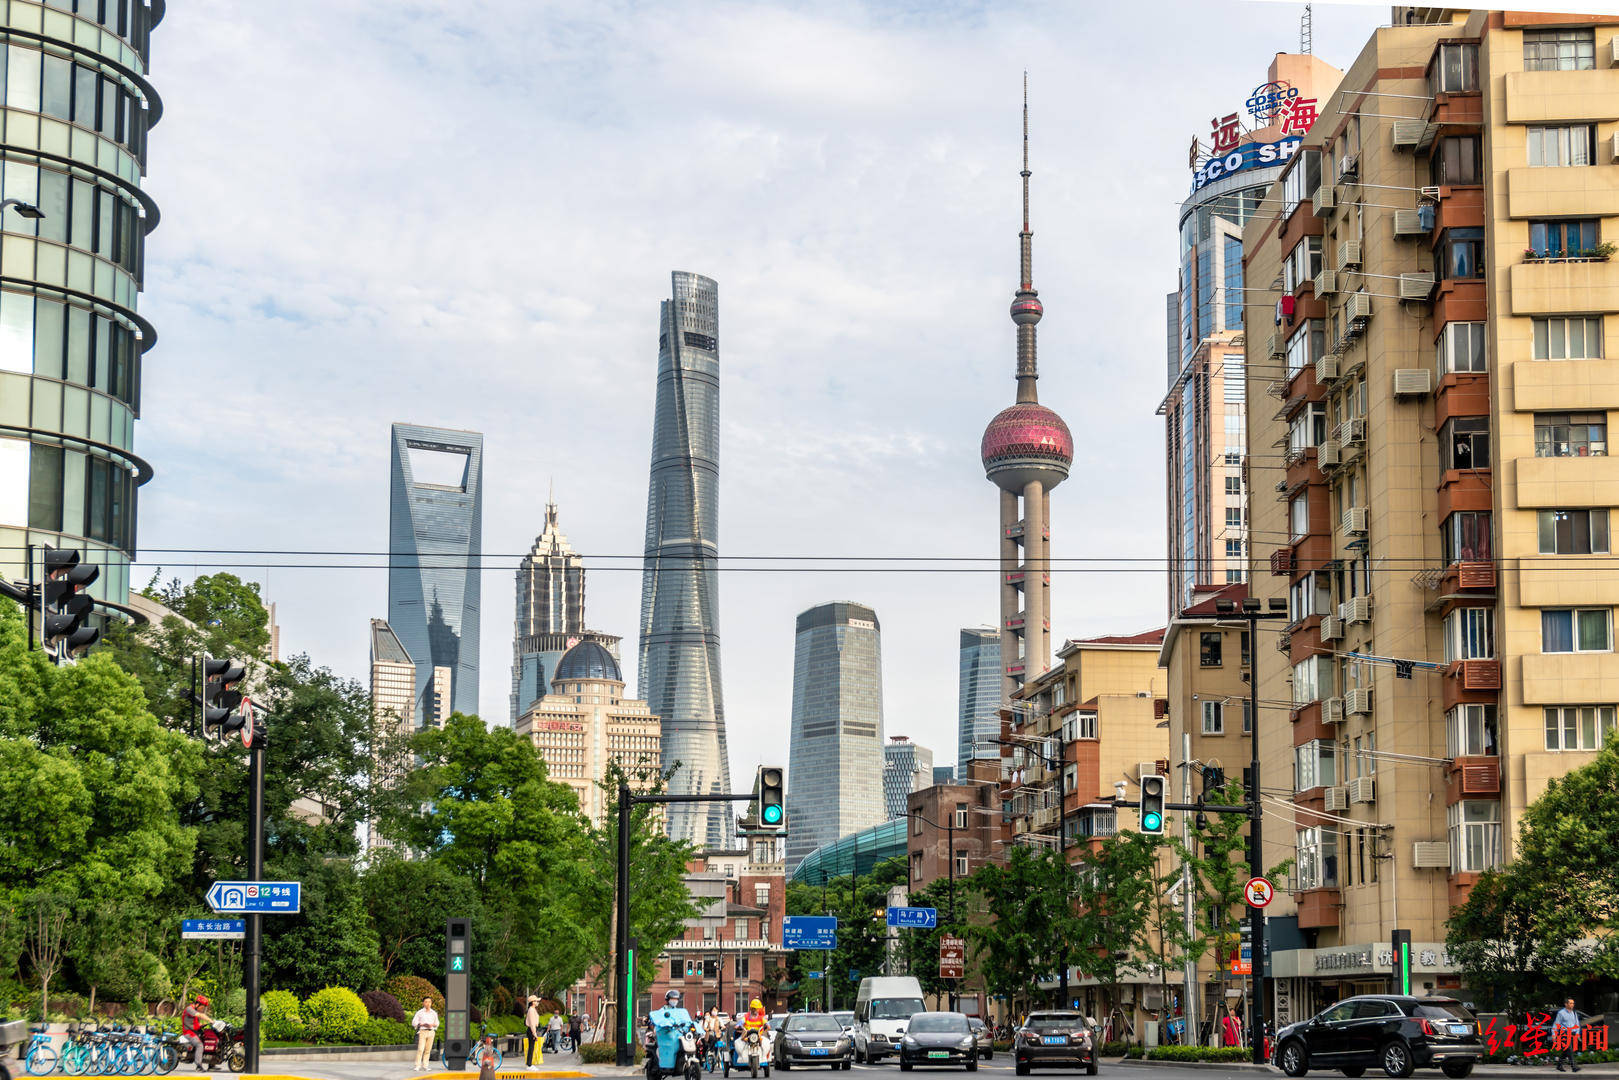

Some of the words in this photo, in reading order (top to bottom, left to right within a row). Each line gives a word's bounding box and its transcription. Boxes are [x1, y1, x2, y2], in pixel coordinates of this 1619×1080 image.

[1245, 87, 1298, 109] COSCO
[197, 922, 231, 931] 东长治路
